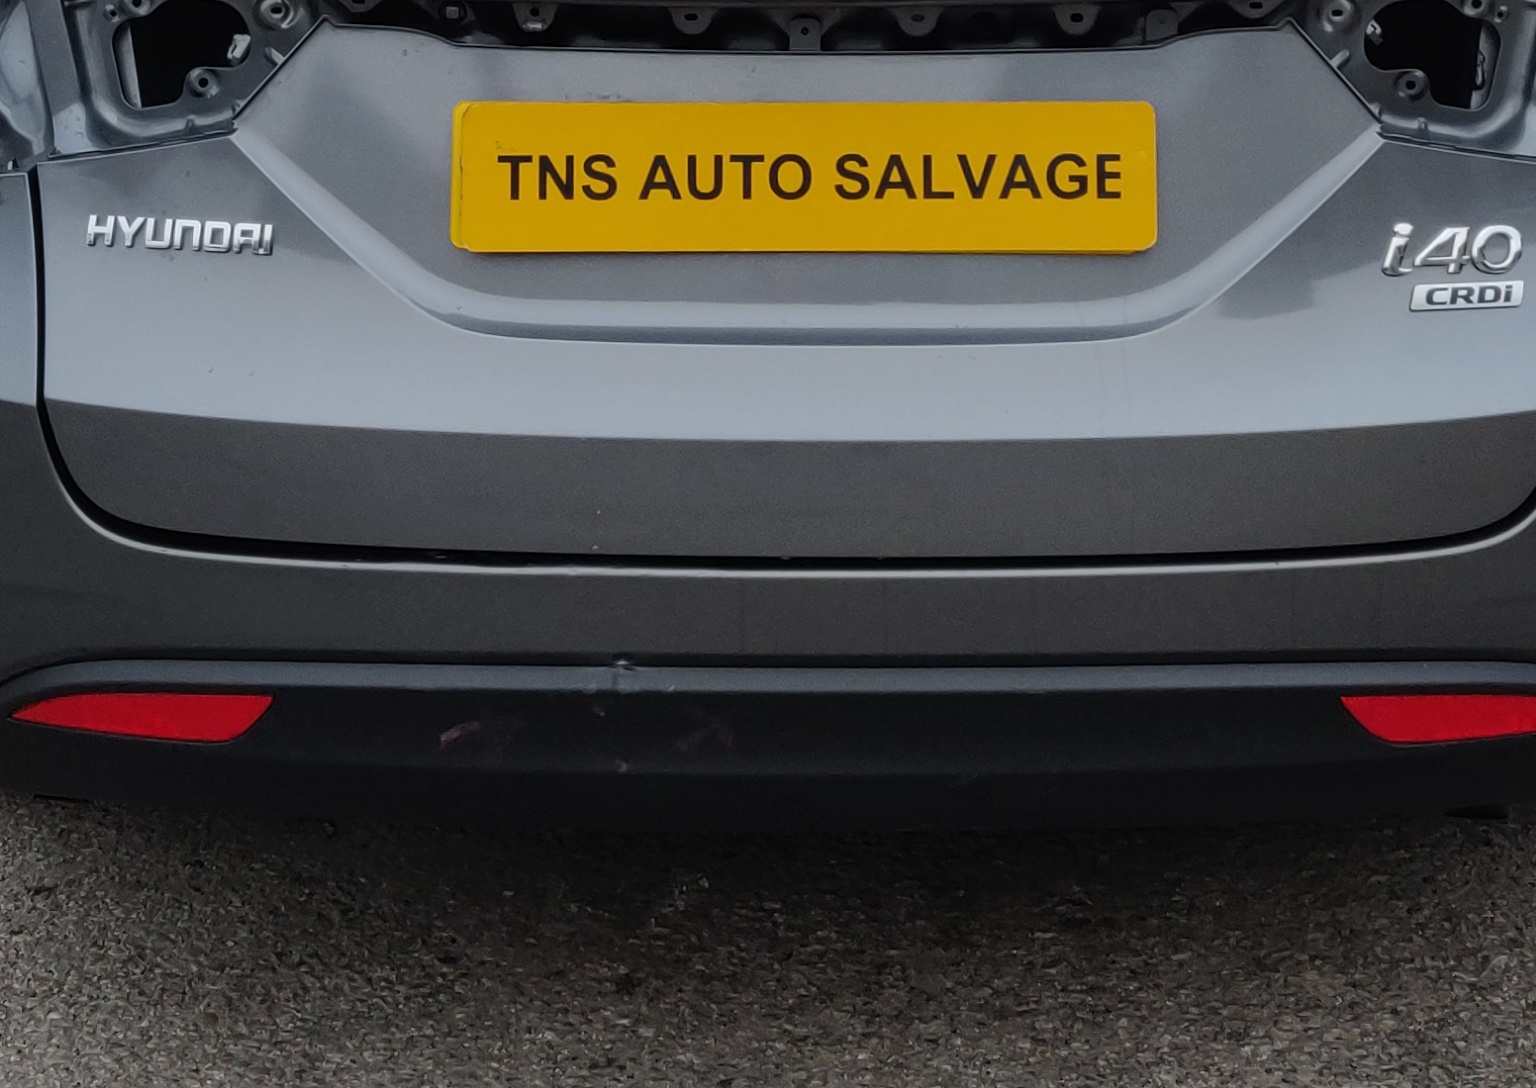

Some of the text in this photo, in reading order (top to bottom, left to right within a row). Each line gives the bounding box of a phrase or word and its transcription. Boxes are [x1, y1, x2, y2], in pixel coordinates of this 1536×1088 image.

[497, 153, 1121, 201] TNS AUTO SALVAGE
[86, 214, 273, 256] HYUNDAI
[1381, 222, 1524, 277] i40
[1425, 285, 1514, 306] CRDi
